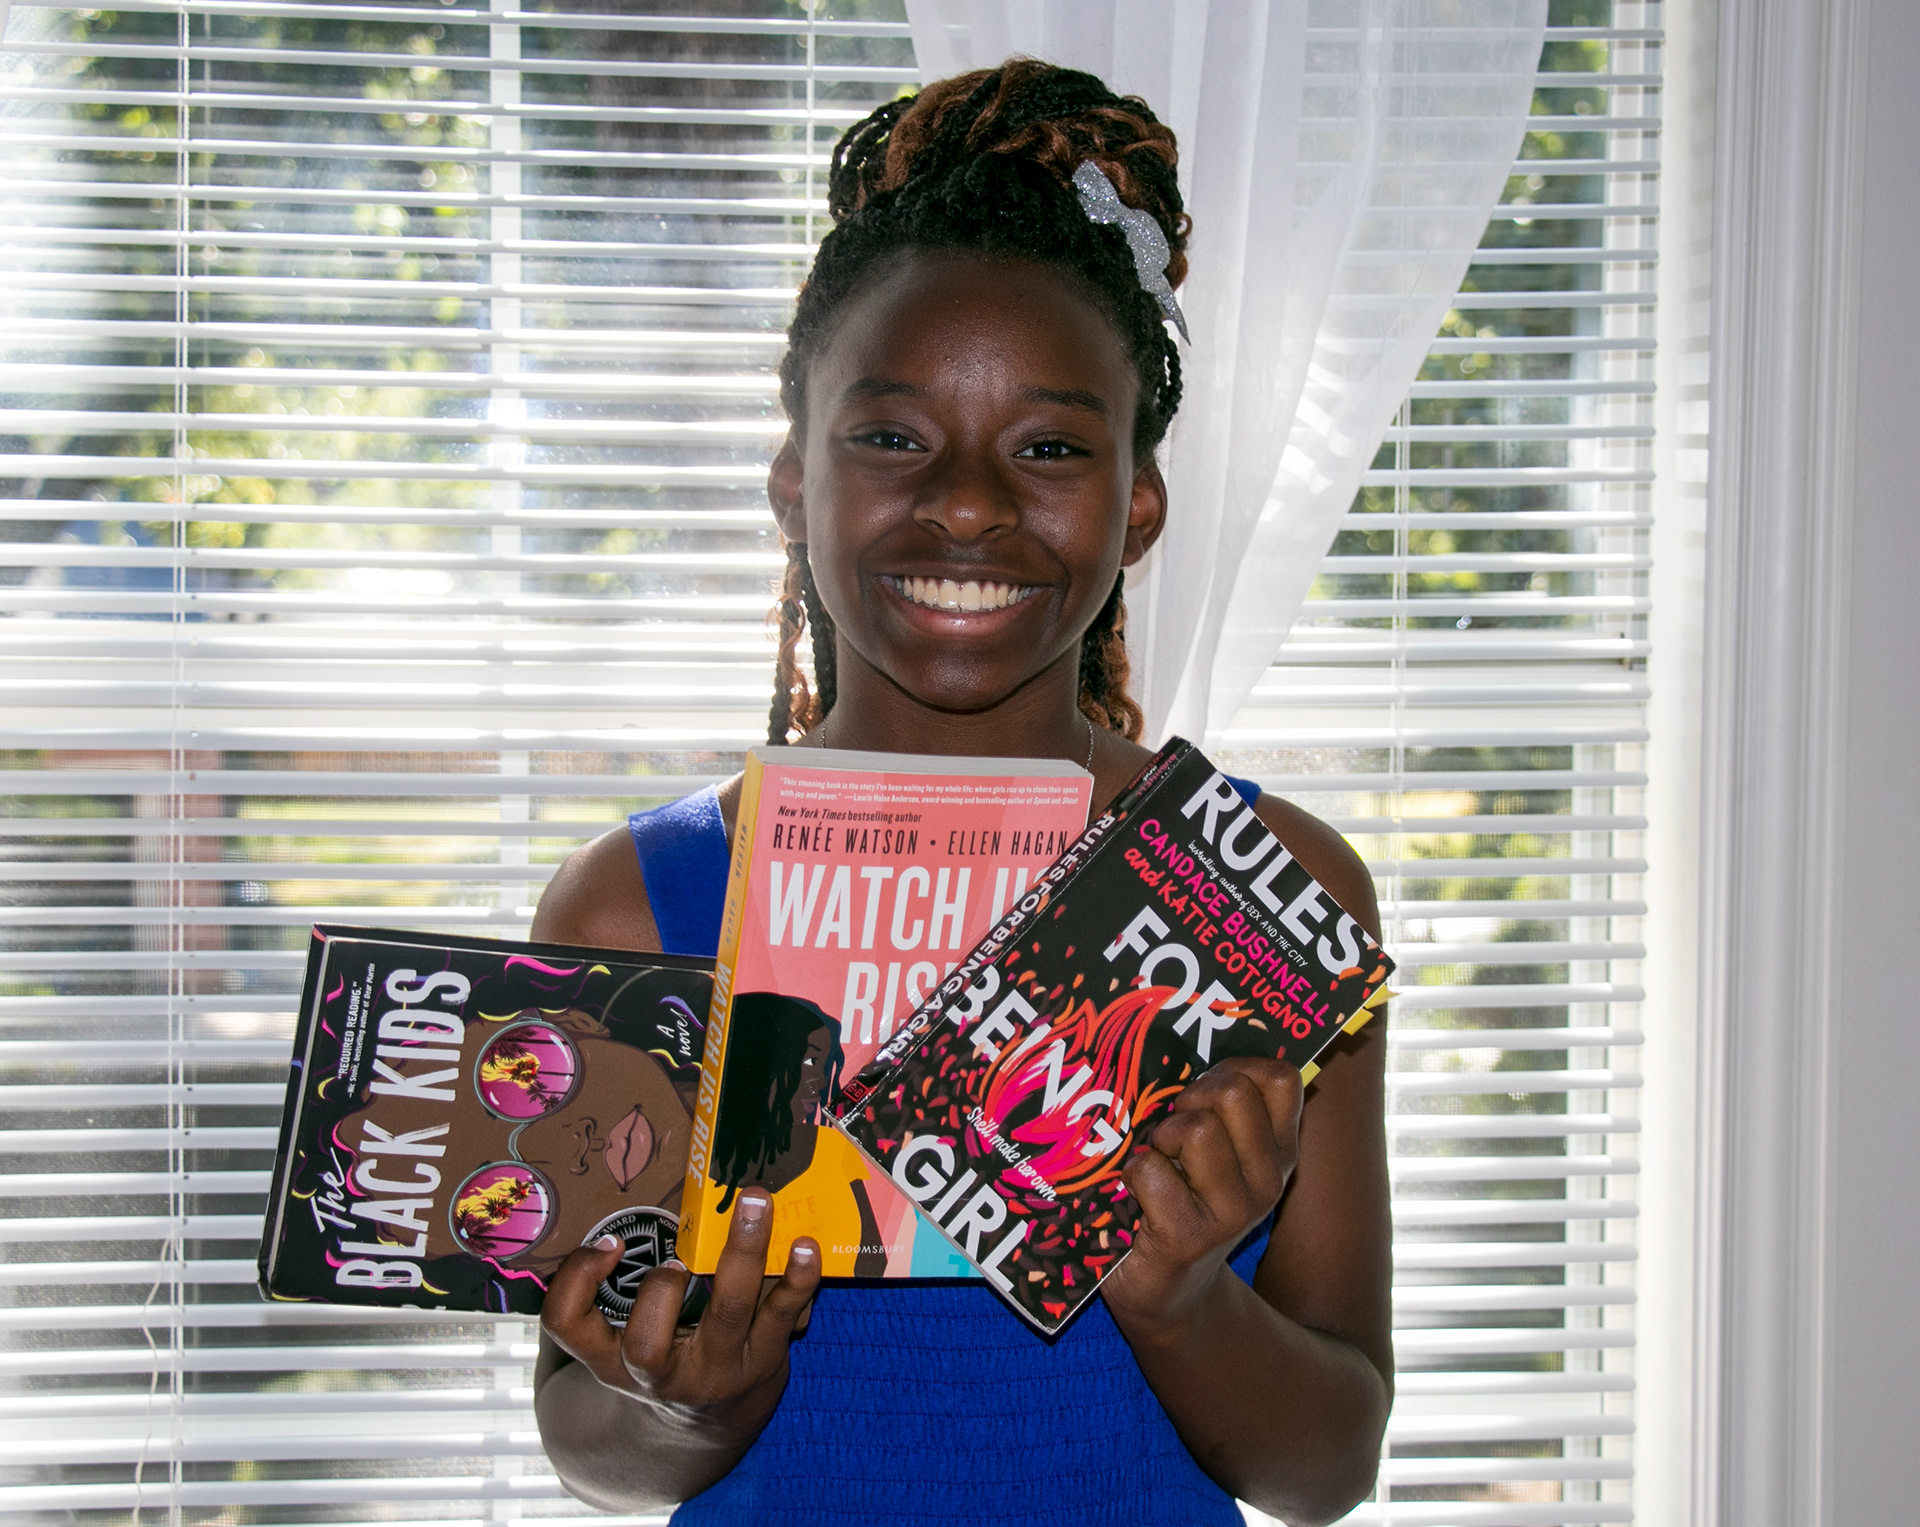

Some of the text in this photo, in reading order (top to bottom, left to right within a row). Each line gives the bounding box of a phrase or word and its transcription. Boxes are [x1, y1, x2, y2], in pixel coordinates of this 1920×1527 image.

[778, 805, 922, 824] New York Times bestselling author
[780, 789, 795, 798] with
[795, 791, 805, 800] joy
[805, 791, 818, 799] and
[1007, 797, 1026, 805] author
[1050, 797, 1062, 805] and
[798, 780, 826, 790] stunning
[826, 781, 841, 790] book
[849, 782, 859, 790] the
[860, 783, 876, 792] story
[887, 783, 903, 792] been
[903, 784, 925, 794] waiting
[925, 784, 935, 793] for
[935, 786, 945, 794] my
[944, 784, 963, 793] whole
[974, 785, 992, 794] where
[992, 785, 1006, 795] girls
[1006, 786, 1018, 794] rise
[1017, 787, 1026, 796] up
[1033, 786, 1048, 794] claim
[1048, 786, 1062, 794] their
[1062, 787, 1079, 796] space
[773, 821, 1068, 855] RENÉE WATSON ELLEN HAGAN
[1180, 771, 1373, 976] RULES
[769, 861, 972, 951] WATCH
[874, 812, 1116, 1062] RULES FOR BEING A GIRL
[1123, 848, 1312, 1040] and KATIE COTUGNO
[1139, 818, 1330, 1027] CANDACE BUSHNELL
[1188, 839, 1309, 968] bestselling author of SEX AND THE CITY
[364, 983, 372, 1000] Dear
[367, 963, 376, 983] Martin
[840, 961, 960, 1045] RIS
[1102, 905, 1240, 1064] FOR
[354, 1030, 367, 1063] bestselling
[360, 1009, 369, 1030] author
[369, 968, 472, 1102] KIDS
[656, 1024, 675, 1039] A
[670, 1007, 692, 1057] novel
[688, 961, 732, 1190] WATCH US RISE
[310, 1146, 357, 1233] The
[967, 1106, 1058, 1202] She'll make her own
[335, 1118, 451, 1289] BLACK
[602, 1214, 637, 1235] AWARD
[892, 1134, 1028, 1293] GIRL
[831, 1244, 905, 1254] BLOOMSBURY
